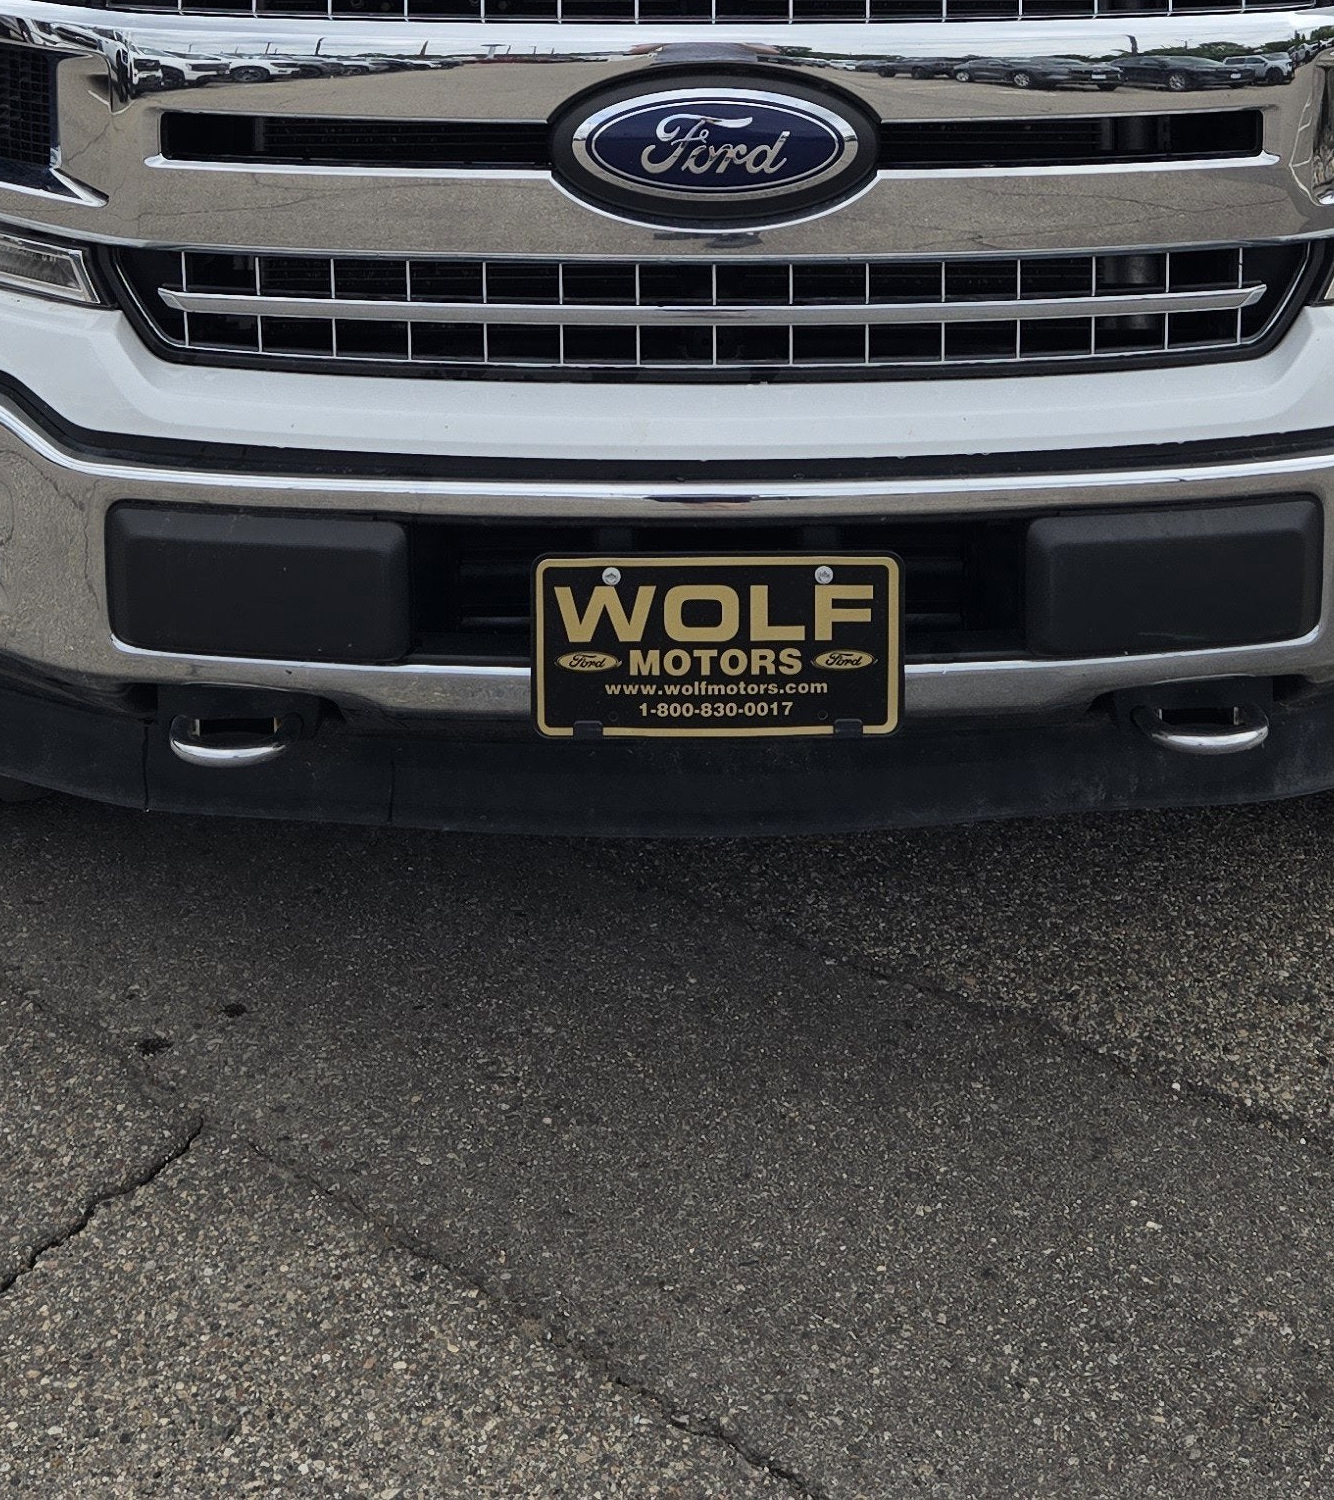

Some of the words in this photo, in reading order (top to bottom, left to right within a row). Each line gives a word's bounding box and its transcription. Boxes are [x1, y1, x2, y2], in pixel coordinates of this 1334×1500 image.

[641, 113, 790, 174] Ford
[553, 584, 874, 643] WOLF
[568, 651, 606, 669] Ford
[629, 647, 803, 677] MOTORS
[824, 649, 863, 667] Ford
[605, 681, 829, 696] www.wolfmotors.com
[638, 702, 794, 718] 1-800-830-0017
